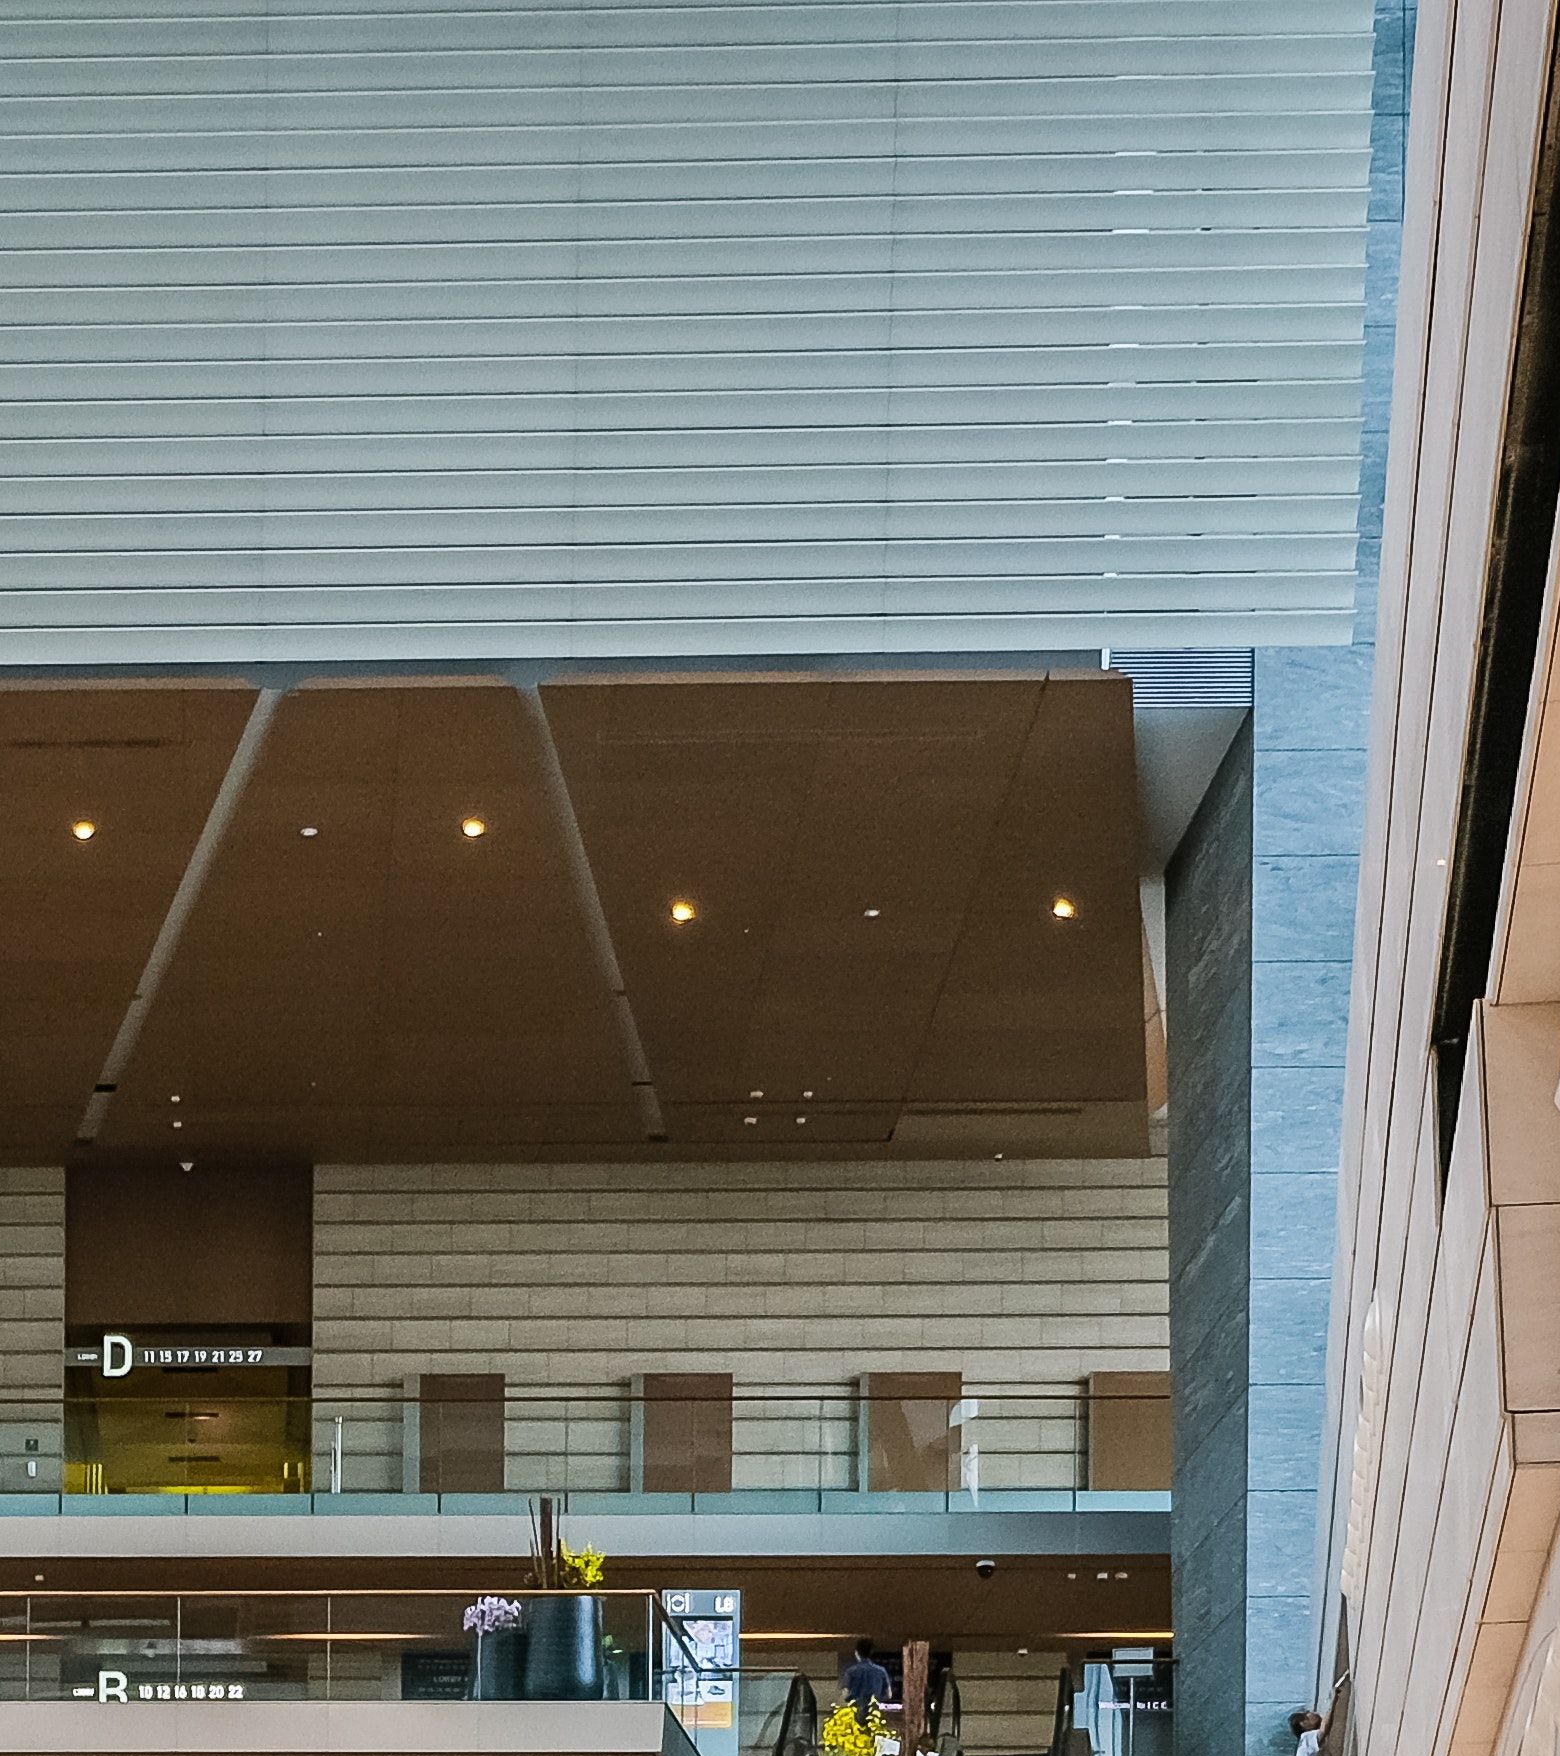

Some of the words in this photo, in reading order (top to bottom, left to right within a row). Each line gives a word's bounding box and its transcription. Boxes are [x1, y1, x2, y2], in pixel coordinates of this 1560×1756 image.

[102, 1334, 133, 1377] D
[143, 1350, 155, 1363] 11
[176, 1350, 190, 1363] 17
[194, 1350, 207, 1363] 19
[211, 1350, 225, 1363] 21
[247, 1350, 263, 1363] 27
[138, 1685, 153, 1699] 10
[156, 1685, 171, 1699] 12
[208, 1685, 225, 1699] 20
[227, 1685, 244, 1699] 22
